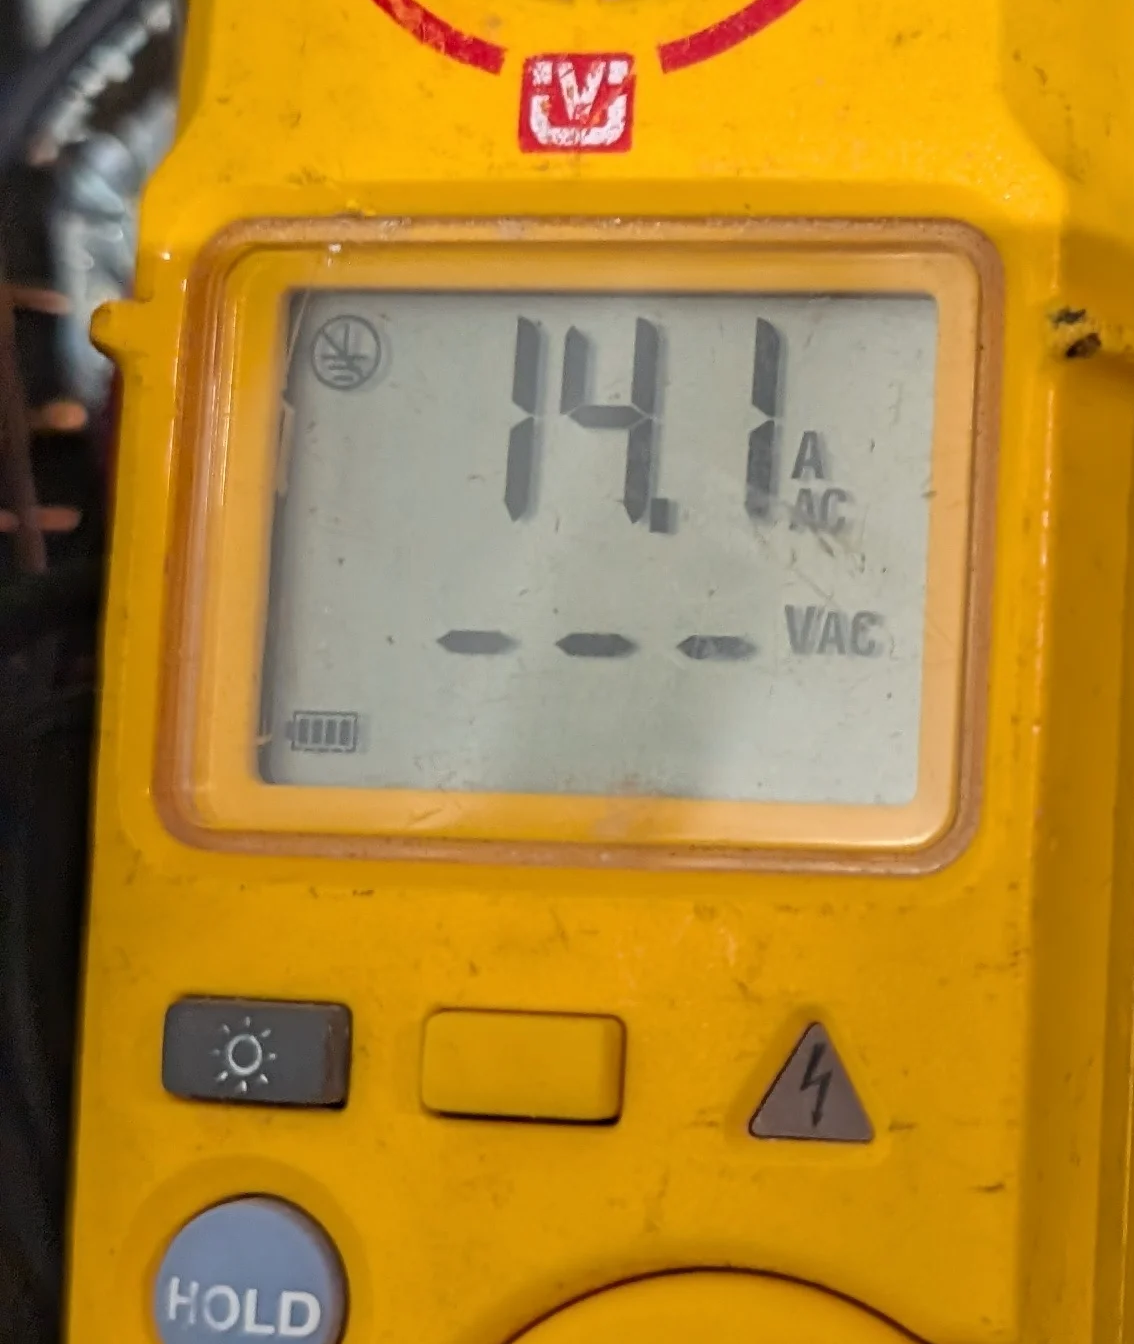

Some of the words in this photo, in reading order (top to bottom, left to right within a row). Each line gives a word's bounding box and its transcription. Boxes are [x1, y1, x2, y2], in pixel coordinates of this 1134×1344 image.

[503, 315, 785, 534] 14.1
[791, 430, 825, 480] A
[792, 488, 848, 533] AC
[784, 604, 884, 658] VAC
[164, 1278, 322, 1339] HOLD
